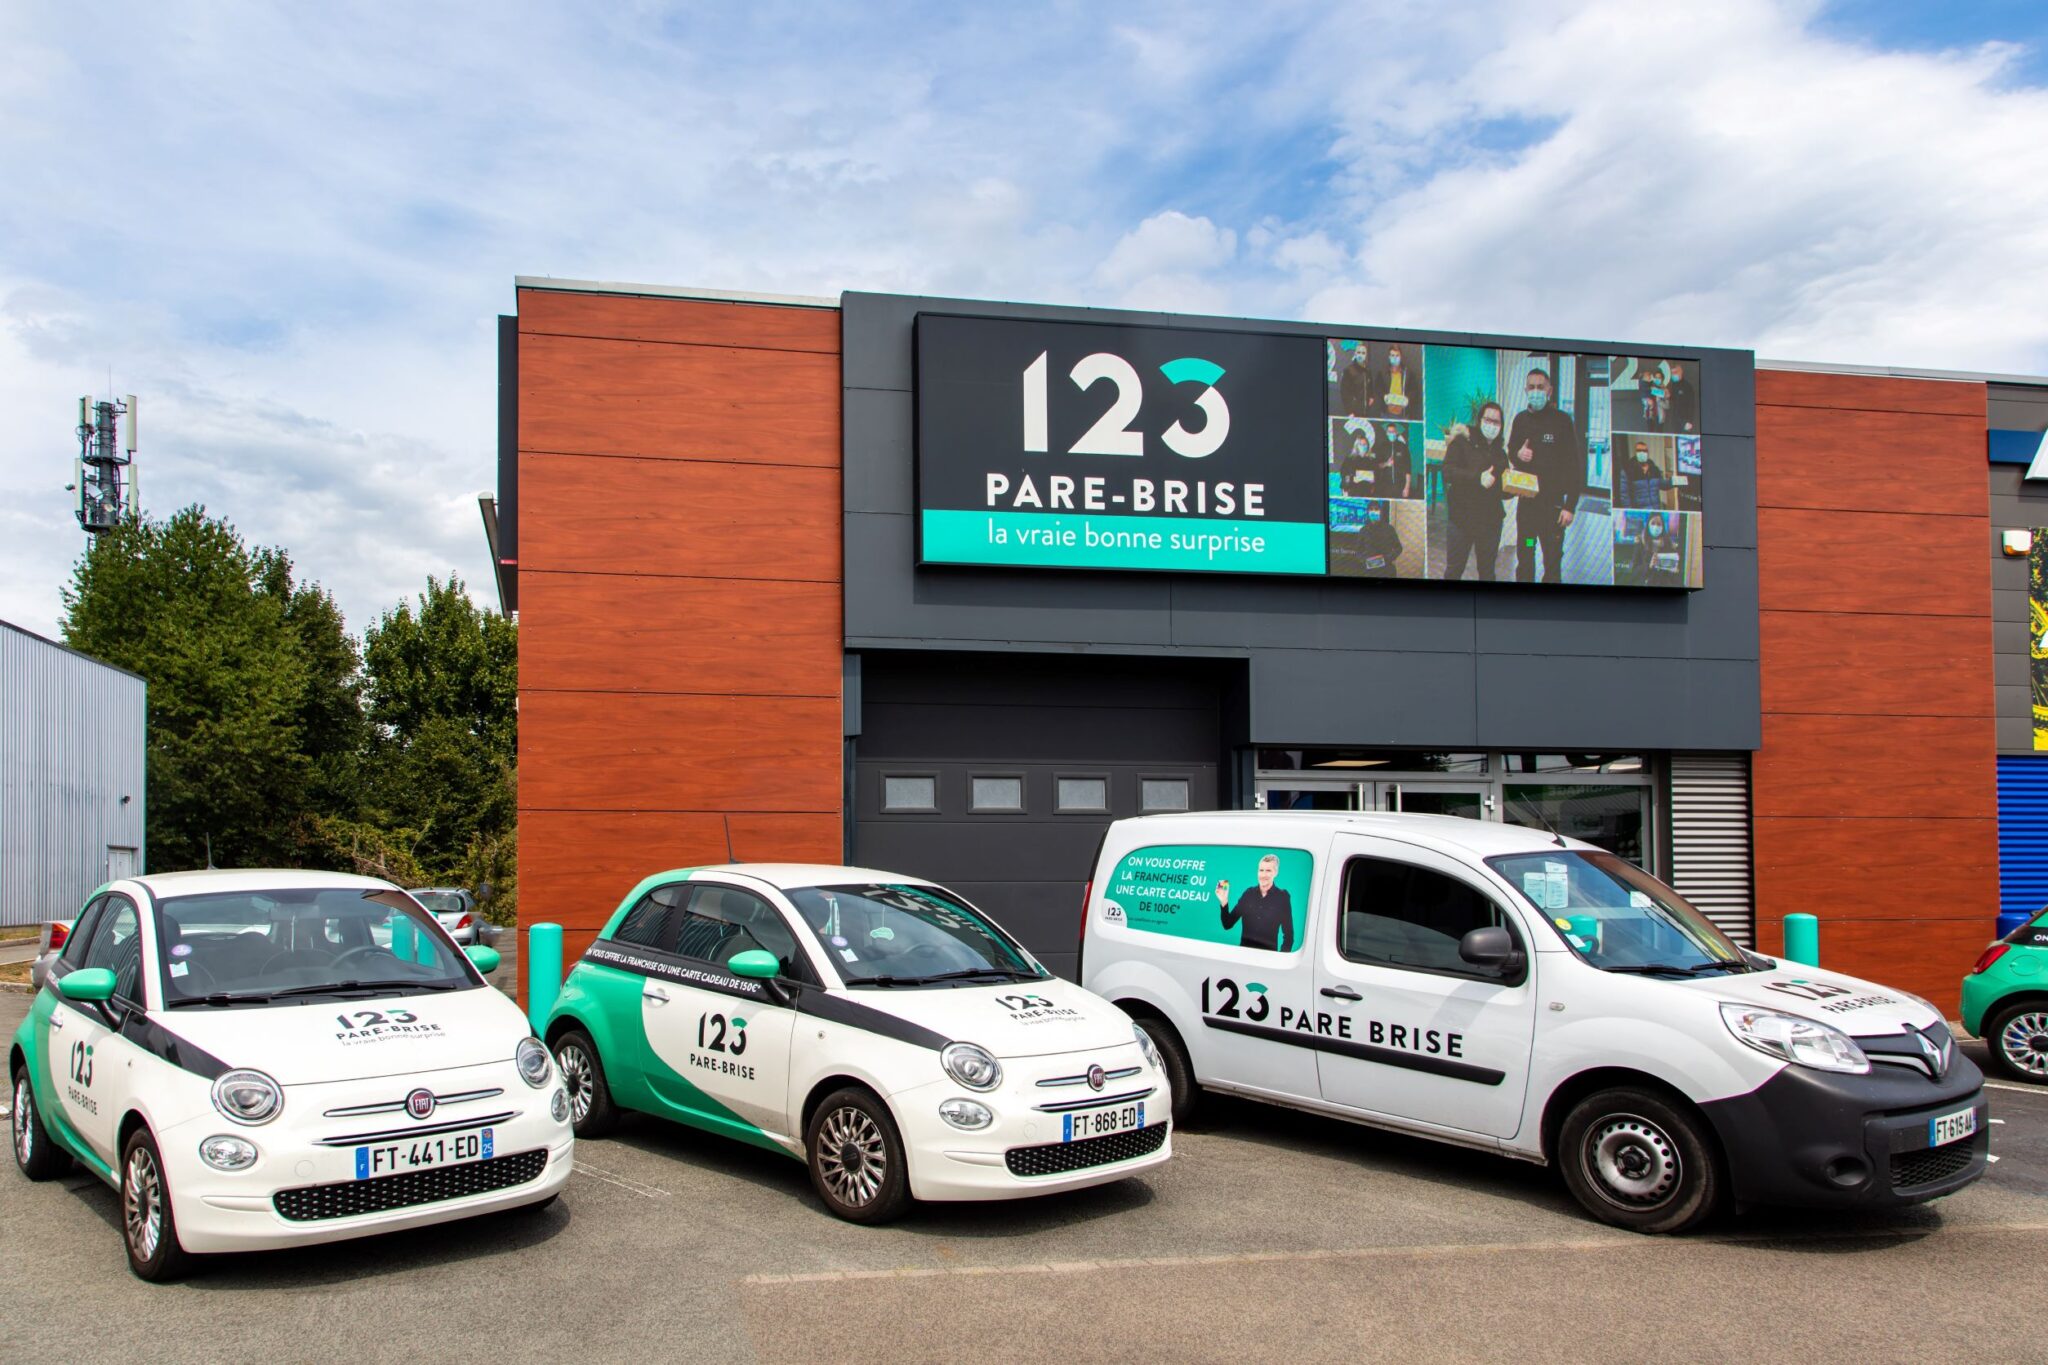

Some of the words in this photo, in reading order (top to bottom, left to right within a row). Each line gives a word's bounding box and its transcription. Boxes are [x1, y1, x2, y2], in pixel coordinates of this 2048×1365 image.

[1023, 350, 1230, 458] 123
[986, 473, 1265, 516] PARE-BRISE
[988, 518, 1007, 544] la
[1016, 521, 1076, 546] vraie
[1085, 521, 1162, 549] bonne
[1170, 527, 1265, 560] surprise
[1128, 857, 1143, 866] ON
[1145, 858, 1171, 868] VOUS
[1172, 859, 1206, 871] OFFRE
[1121, 870, 1133, 880] LA
[1134, 871, 1189, 885] FRANCHISE
[1190, 876, 1207, 886] OU
[1115, 885, 1135, 896] UNE
[1136, 887, 1167, 898] CARTE
[1168, 888, 1210, 902] CADEAU
[1107, 907, 1121, 916] 123
[1139, 901, 1152, 912] DE
[592, 948, 605, 958] VOUS
[605, 951, 621, 962] OFFRE
[620, 954, 627, 963] LA
[628, 956, 658, 970] FRANCHISE
[657, 963, 668, 972] OU
[667, 965, 681, 976] UNE
[681, 968, 701, 980] CARTE
[701, 972, 730, 986] CADEAU
[729, 979, 740, 989] DE
[995, 995, 1053, 1010] 123
[336, 1009, 418, 1029] 123
[1202, 976, 1269, 1022] 123
[1281, 1007, 1352, 1039] PARE
[1369, 1021, 1463, 1058] BRISE
[336, 1024, 441, 1040] PARE-BRISE
[698, 1011, 748, 1056] 123
[71, 1040, 94, 1088] 123
[690, 1053, 755, 1080] PARE-BRISE
[414, 1097, 429, 1111] FIAT
[1073, 1107, 1136, 1136] FT-868-ED
[373, 1135, 478, 1172] FT-441-ED
[482, 1143, 493, 1154] 25
[360, 1163, 365, 1171] F
